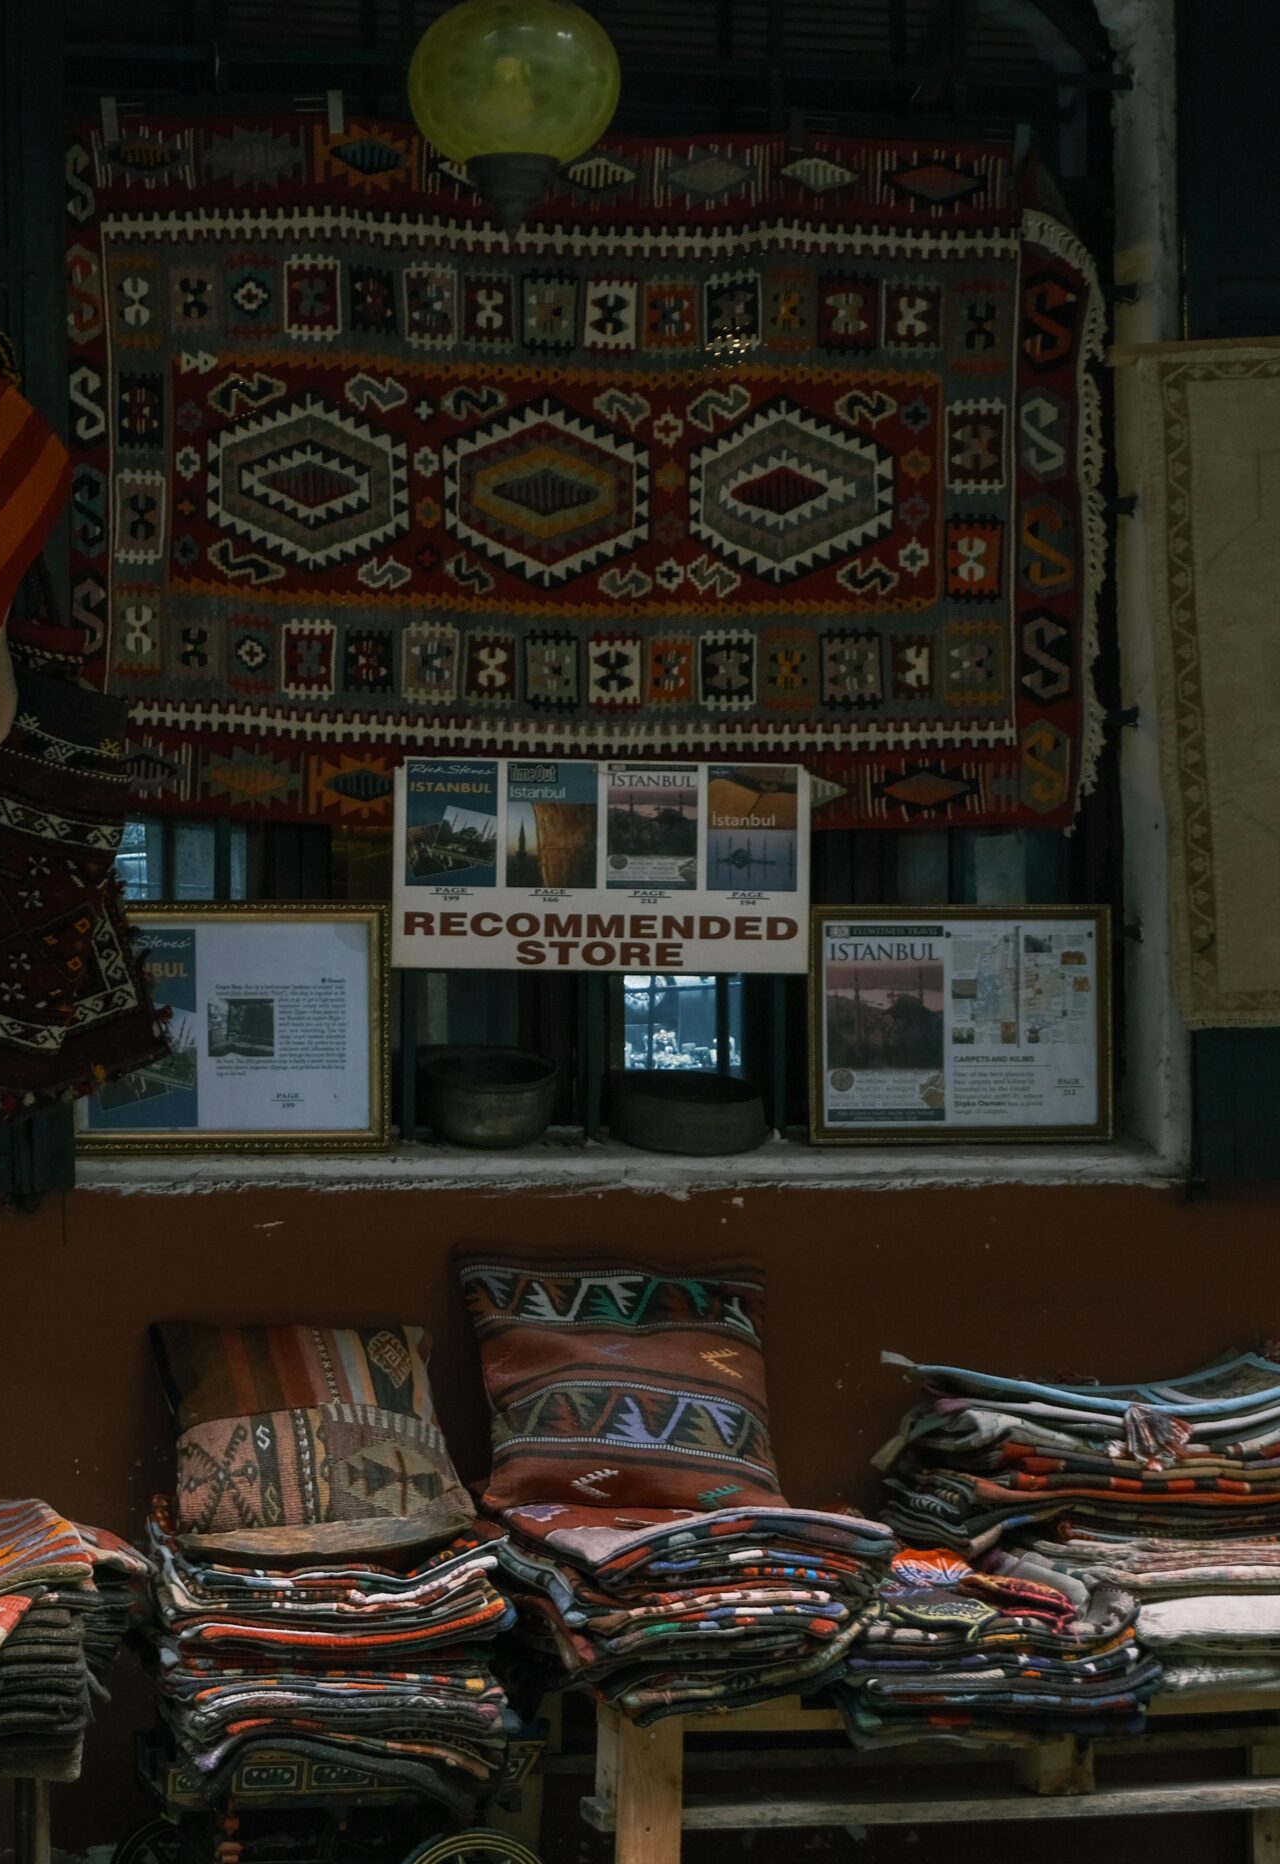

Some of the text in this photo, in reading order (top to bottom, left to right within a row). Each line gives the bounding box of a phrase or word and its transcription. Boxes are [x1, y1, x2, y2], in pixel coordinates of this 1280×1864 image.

[409, 764, 446, 774] Rick
[610, 773, 696, 787] ISTANBUL
[410, 781, 492, 794] ISTANBUL
[509, 786, 567, 799] Istanbul
[403, 911, 799, 940] RECOMMENDED
[516, 940, 684, 966] STORE
[830, 943, 940, 961] ISTANBUL
